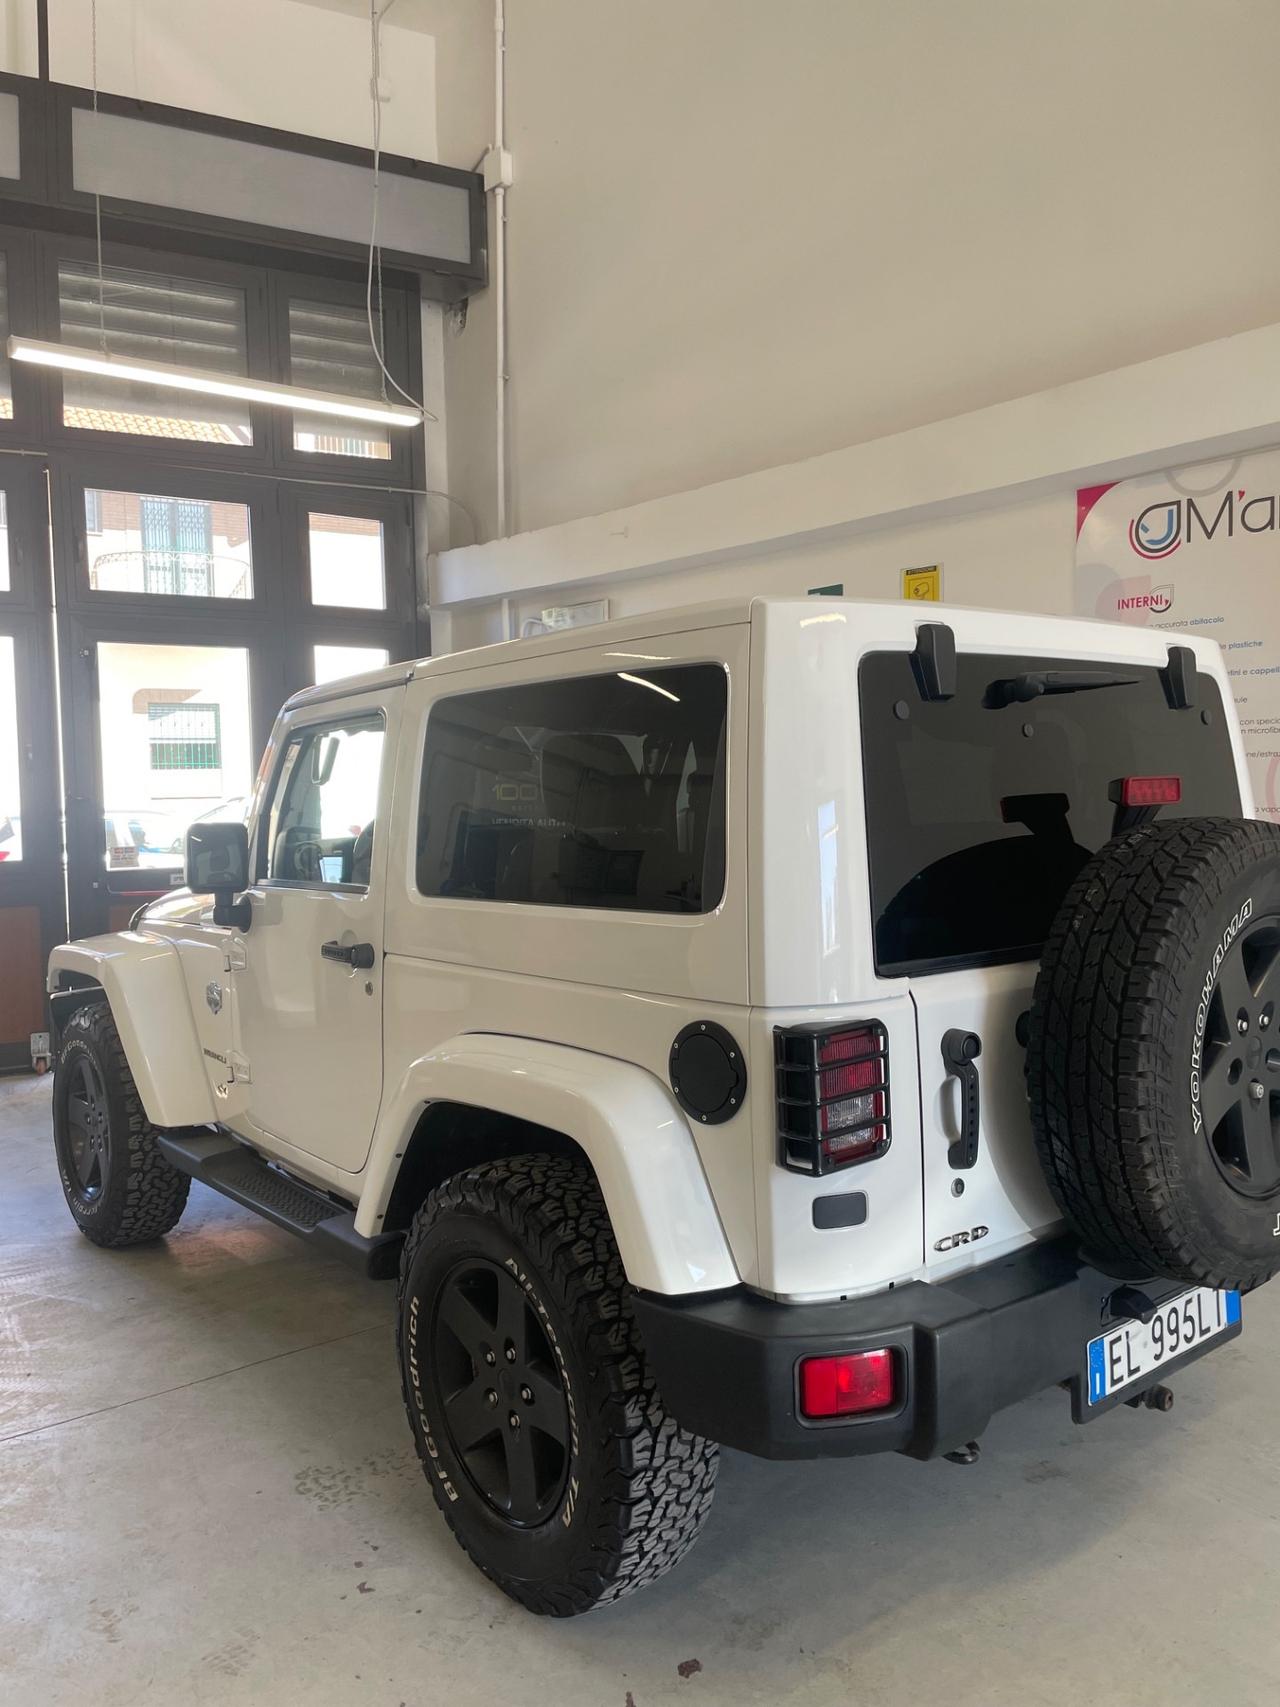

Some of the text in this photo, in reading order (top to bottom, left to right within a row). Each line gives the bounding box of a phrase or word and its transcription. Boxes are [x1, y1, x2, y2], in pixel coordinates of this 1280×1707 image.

[1117, 595, 1164, 611] INTERNI
[1228, 640, 1263, 650] plastiche
[1191, 898, 1252, 1134] YOKOHAMA
[934, 1225, 990, 1253] CRD
[1109, 1330, 1141, 1388] EL
[408, 1295, 460, 1503] BFGoodrich
